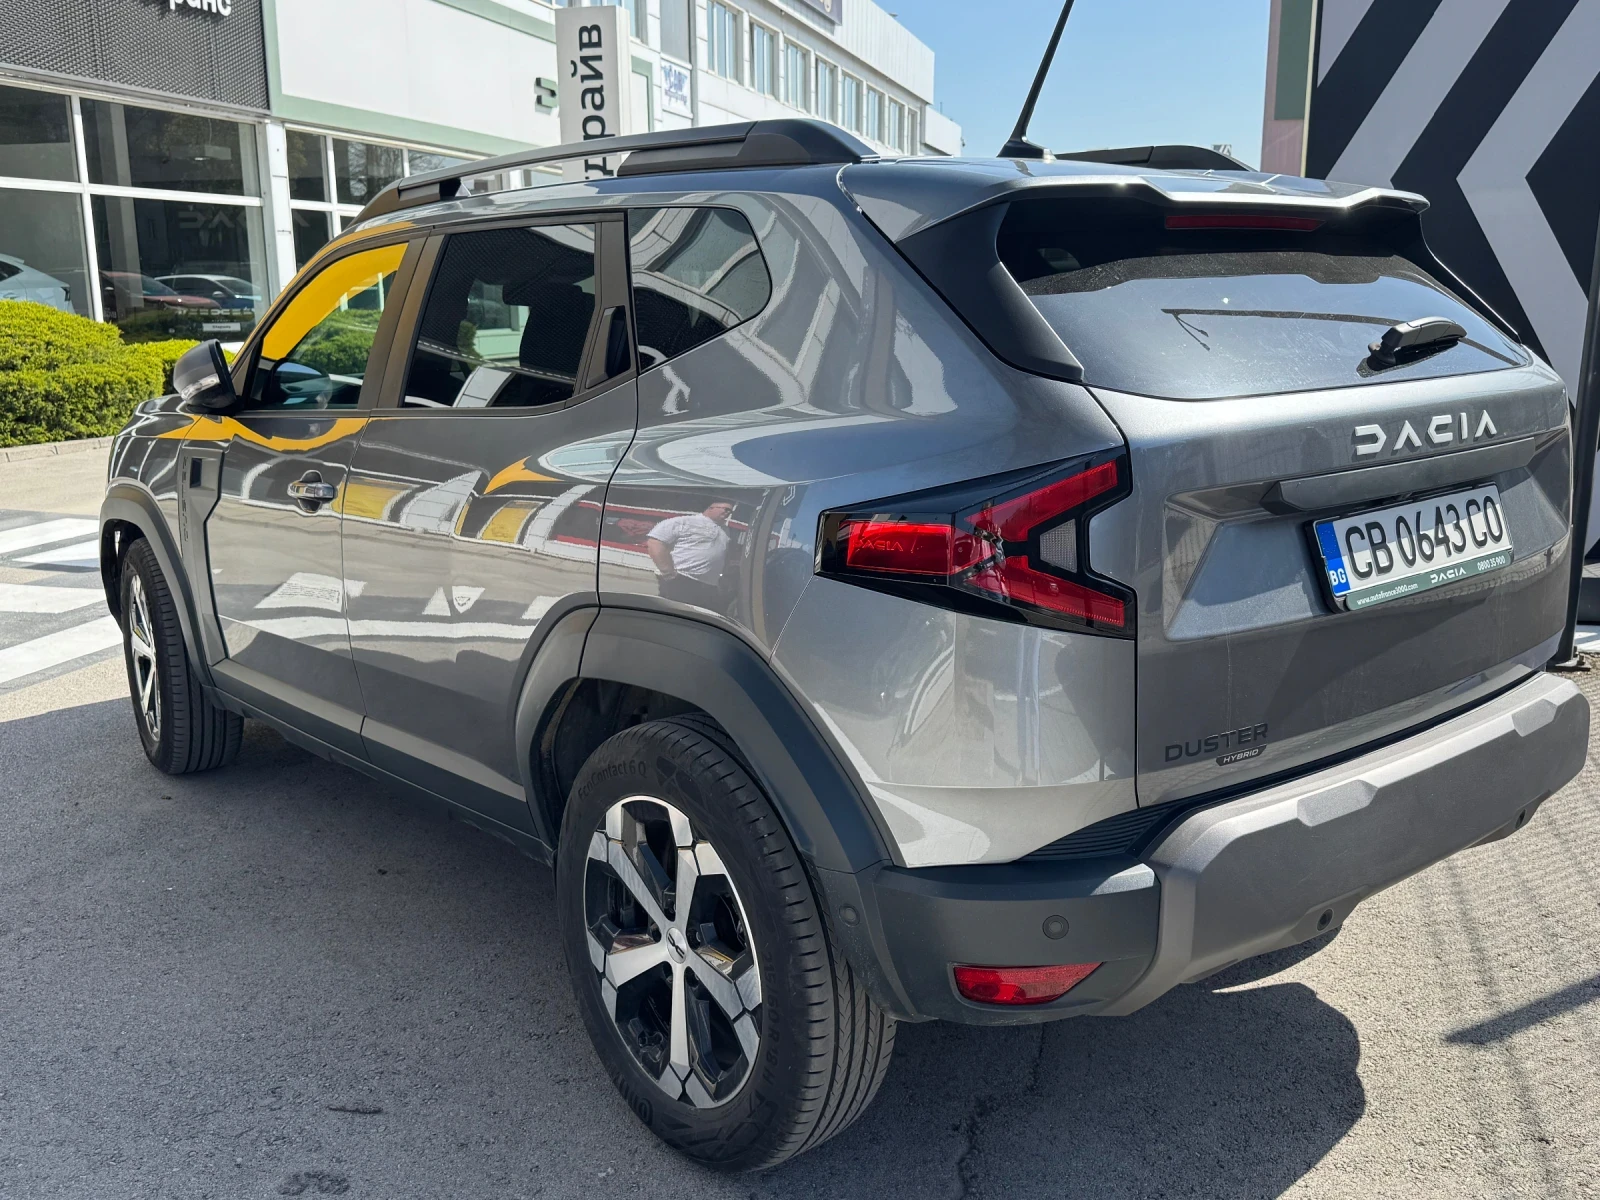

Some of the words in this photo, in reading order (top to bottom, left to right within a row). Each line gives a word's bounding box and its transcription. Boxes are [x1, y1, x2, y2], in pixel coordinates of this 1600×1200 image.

[1354, 409, 1498, 456] DACIA
[1345, 521, 1394, 580] CB
[1395, 503, 1467, 569] 0643
[1329, 567, 1347, 586] BG
[1430, 566, 1467, 584] DACIA
[1164, 722, 1269, 763] DUSTER
[1222, 748, 1259, 764] HYBRID
[628, 759, 637, 775] 6
